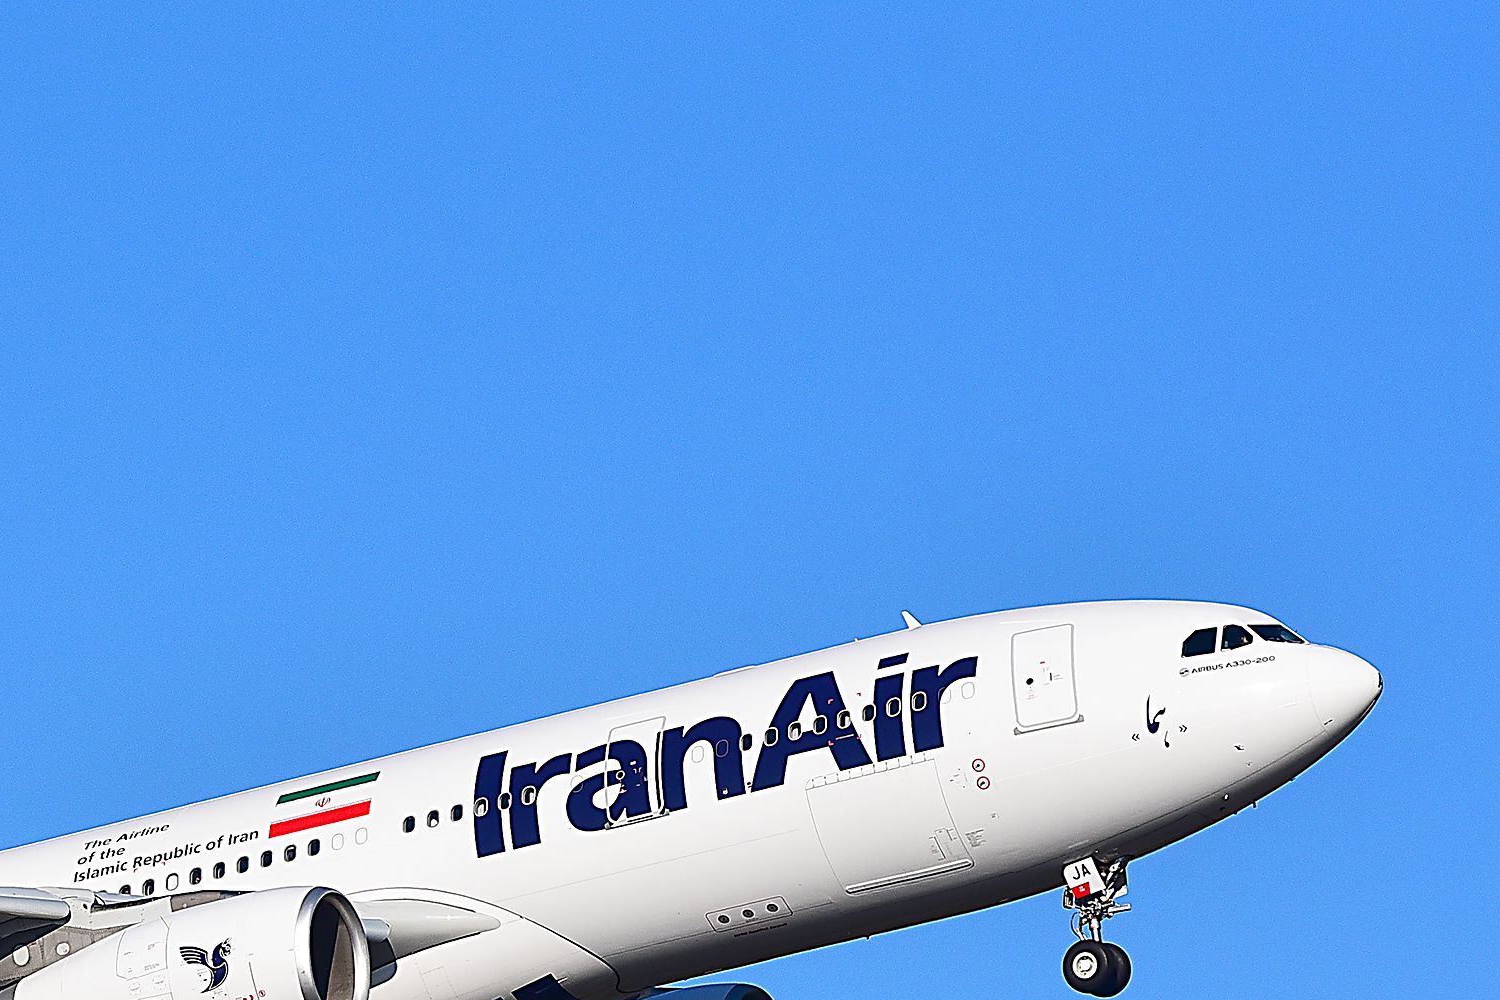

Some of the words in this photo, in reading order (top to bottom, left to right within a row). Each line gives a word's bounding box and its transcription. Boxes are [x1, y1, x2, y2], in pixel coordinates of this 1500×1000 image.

[1191, 663, 1224, 674] AIRBUS
[1226, 656, 1276, 668] A330-200
[474, 652, 979, 859] IranAir
[84, 838, 112, 851] The
[116, 824, 170, 843] Airline
[73, 860, 128, 883] Islamic
[132, 843, 202, 869] Republic
[205, 835, 225, 851] of
[228, 830, 259, 846] Iran
[77, 851, 96, 865] of
[100, 846, 126, 860] the
[1072, 863, 1093, 881] JA
